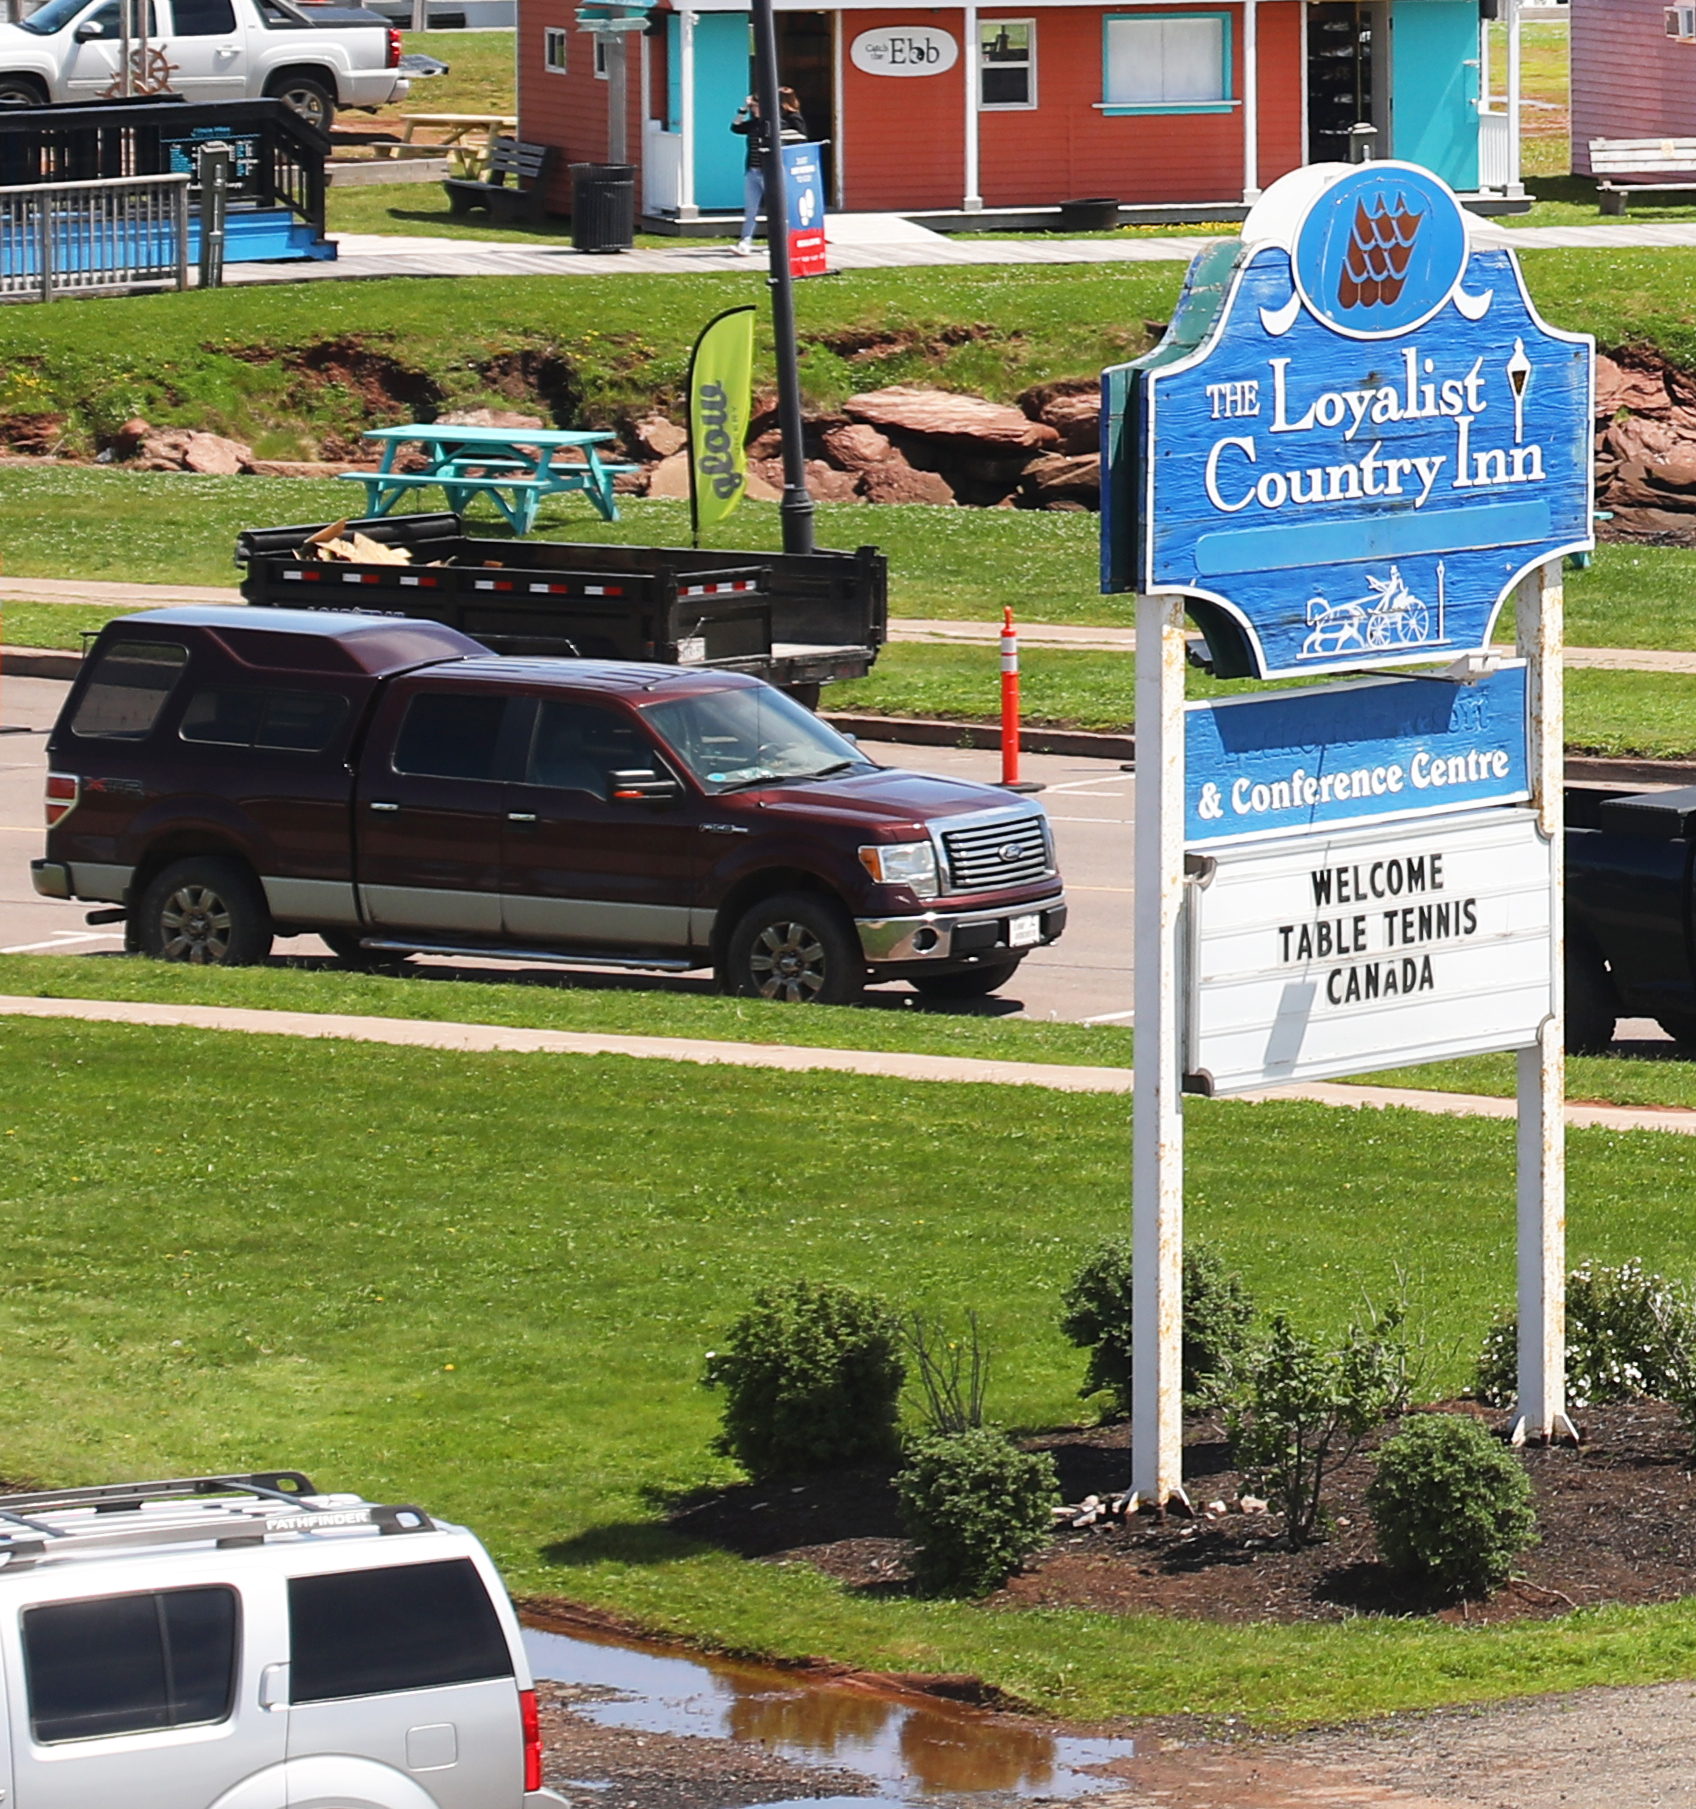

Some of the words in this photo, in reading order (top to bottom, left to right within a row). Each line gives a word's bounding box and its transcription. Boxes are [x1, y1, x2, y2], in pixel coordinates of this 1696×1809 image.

[889, 37, 940, 64] Ebb
[1206, 380, 1260, 420] THE
[1268, 347, 1487, 441] Loyalist
[697, 380, 743, 500] glow
[1204, 436, 1446, 512] Country
[1453, 416, 1546, 487] Inn
[1198, 782, 1224, 820] &
[1231, 768, 1404, 815] Conference
[1410, 747, 1510, 788] Centre
[1311, 853, 1444, 907] WELCOME
[1278, 914, 1367, 962] TABLE
[1384, 898, 1477, 947] TENNIS
[1326, 954, 1435, 1005] CANADA
[265, 1512, 369, 1531] PATHFINDER
